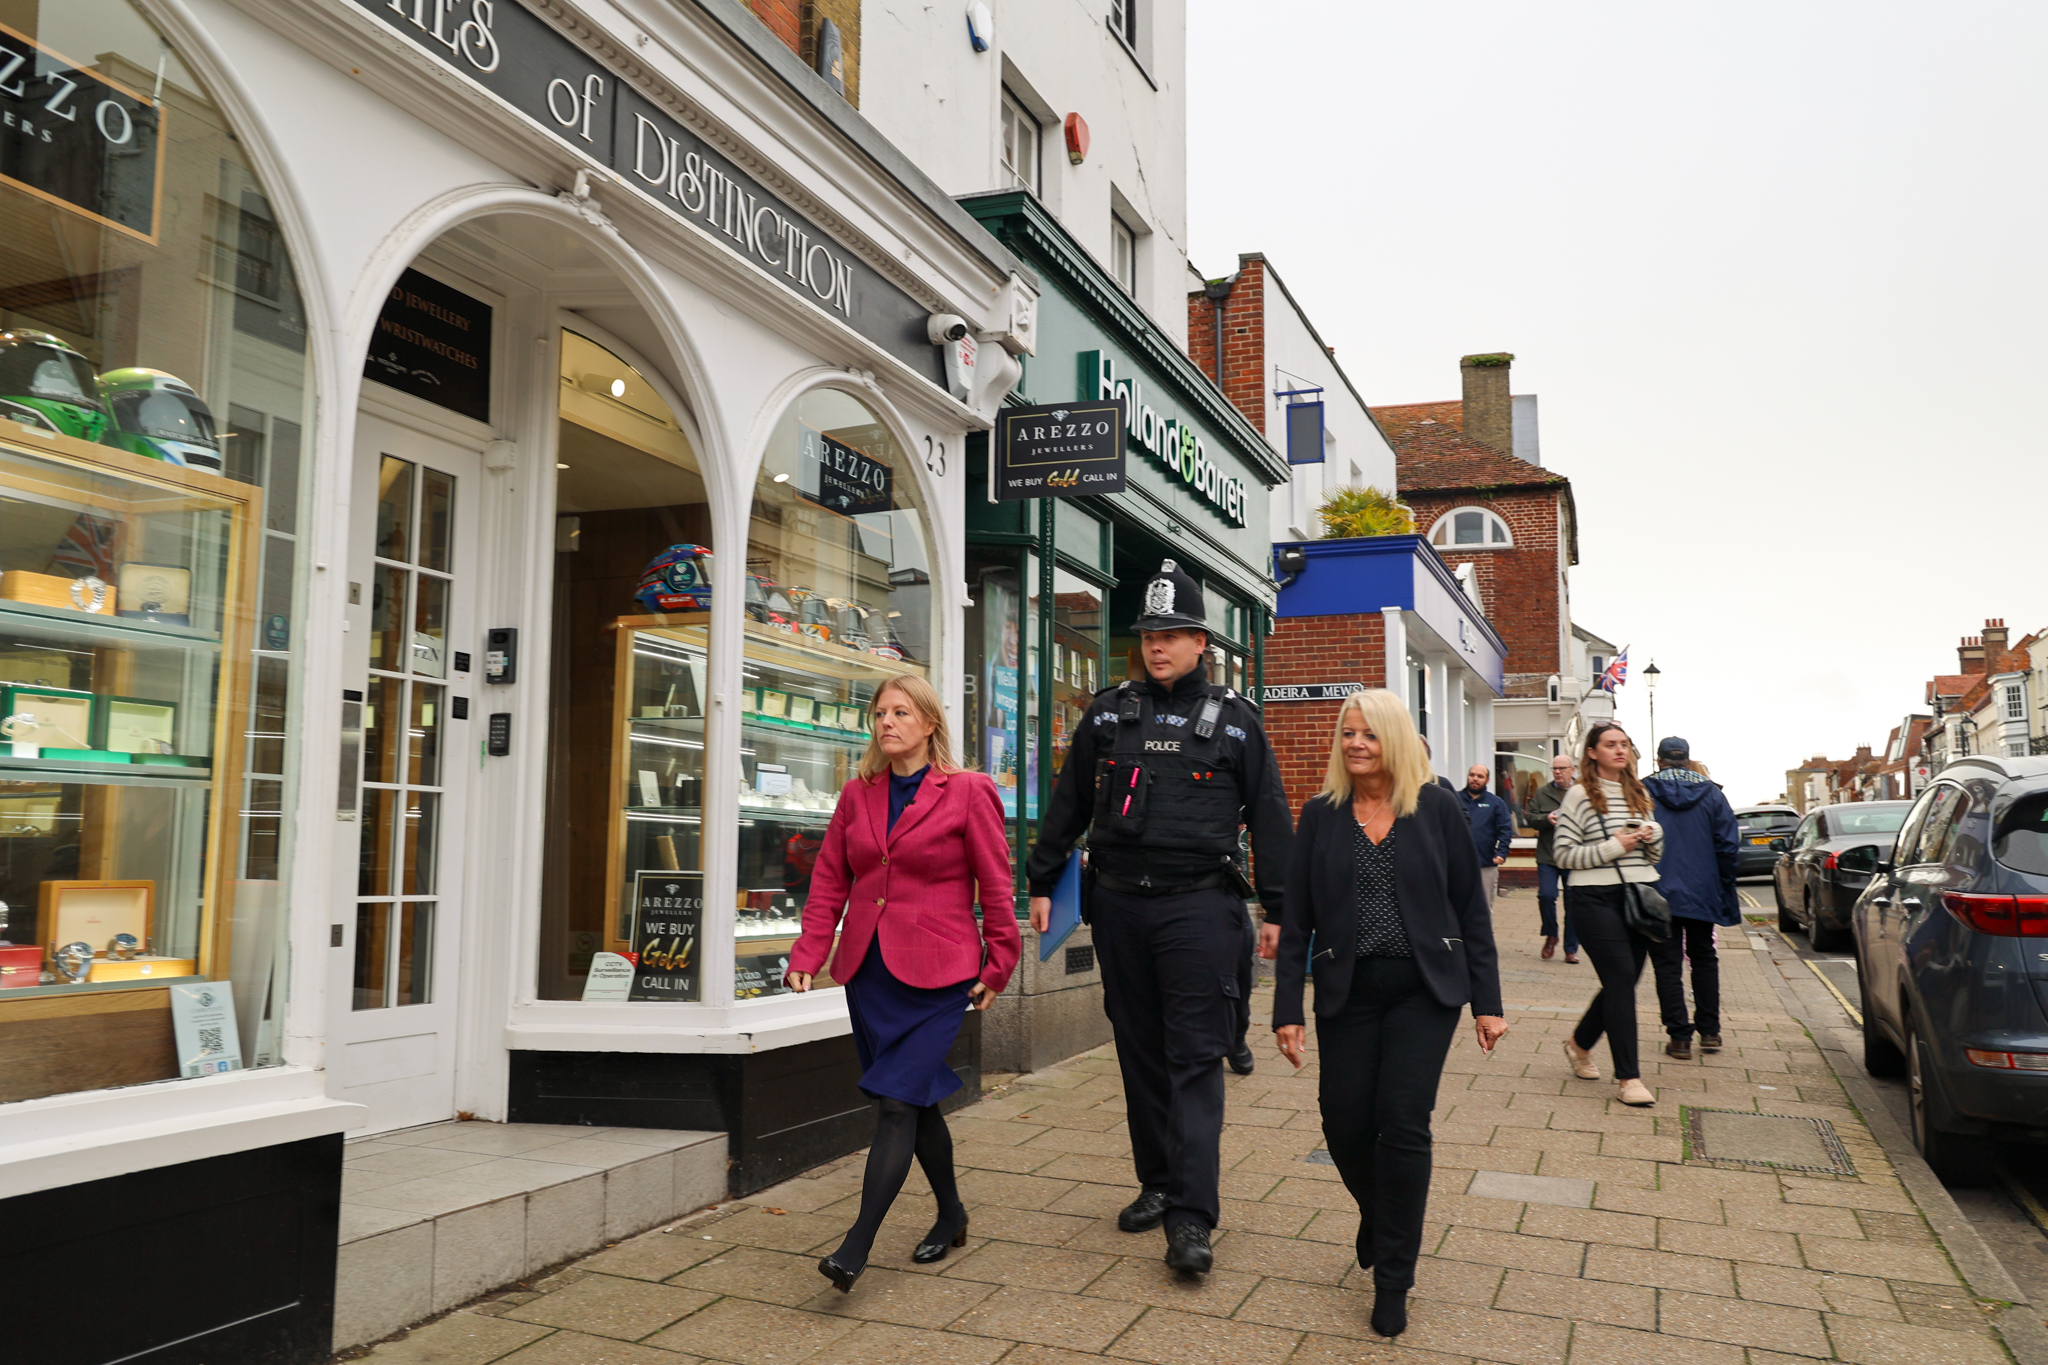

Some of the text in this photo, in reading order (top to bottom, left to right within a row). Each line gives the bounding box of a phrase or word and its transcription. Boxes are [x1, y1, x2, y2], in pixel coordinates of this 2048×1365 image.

[547, 74, 603, 143] of
[633, 112, 853, 317] DISTINCTION
[405, 291, 471, 331] JEWELLERY
[380, 316, 478, 369] WRISTWATCHES
[1017, 421, 1110, 441] AREZZO
[1099, 349, 1181, 473] Holland
[1194, 436, 1249, 528] Barrett
[925, 434, 945, 477] 23
[1031, 443, 1094, 456] JEWELLERS
[803, 434, 885, 491] AREZZO
[824, 474, 866, 498] JEWELLERS
[1008, 468, 1118, 488] WE BUY Gold CALL IN
[1144, 741, 1181, 751] POLICE
[641, 897, 703, 909] AREZZO
[645, 922, 695, 935] WE BUY
[642, 937, 694, 970] Gold
[642, 976, 690, 990] CALL IN
